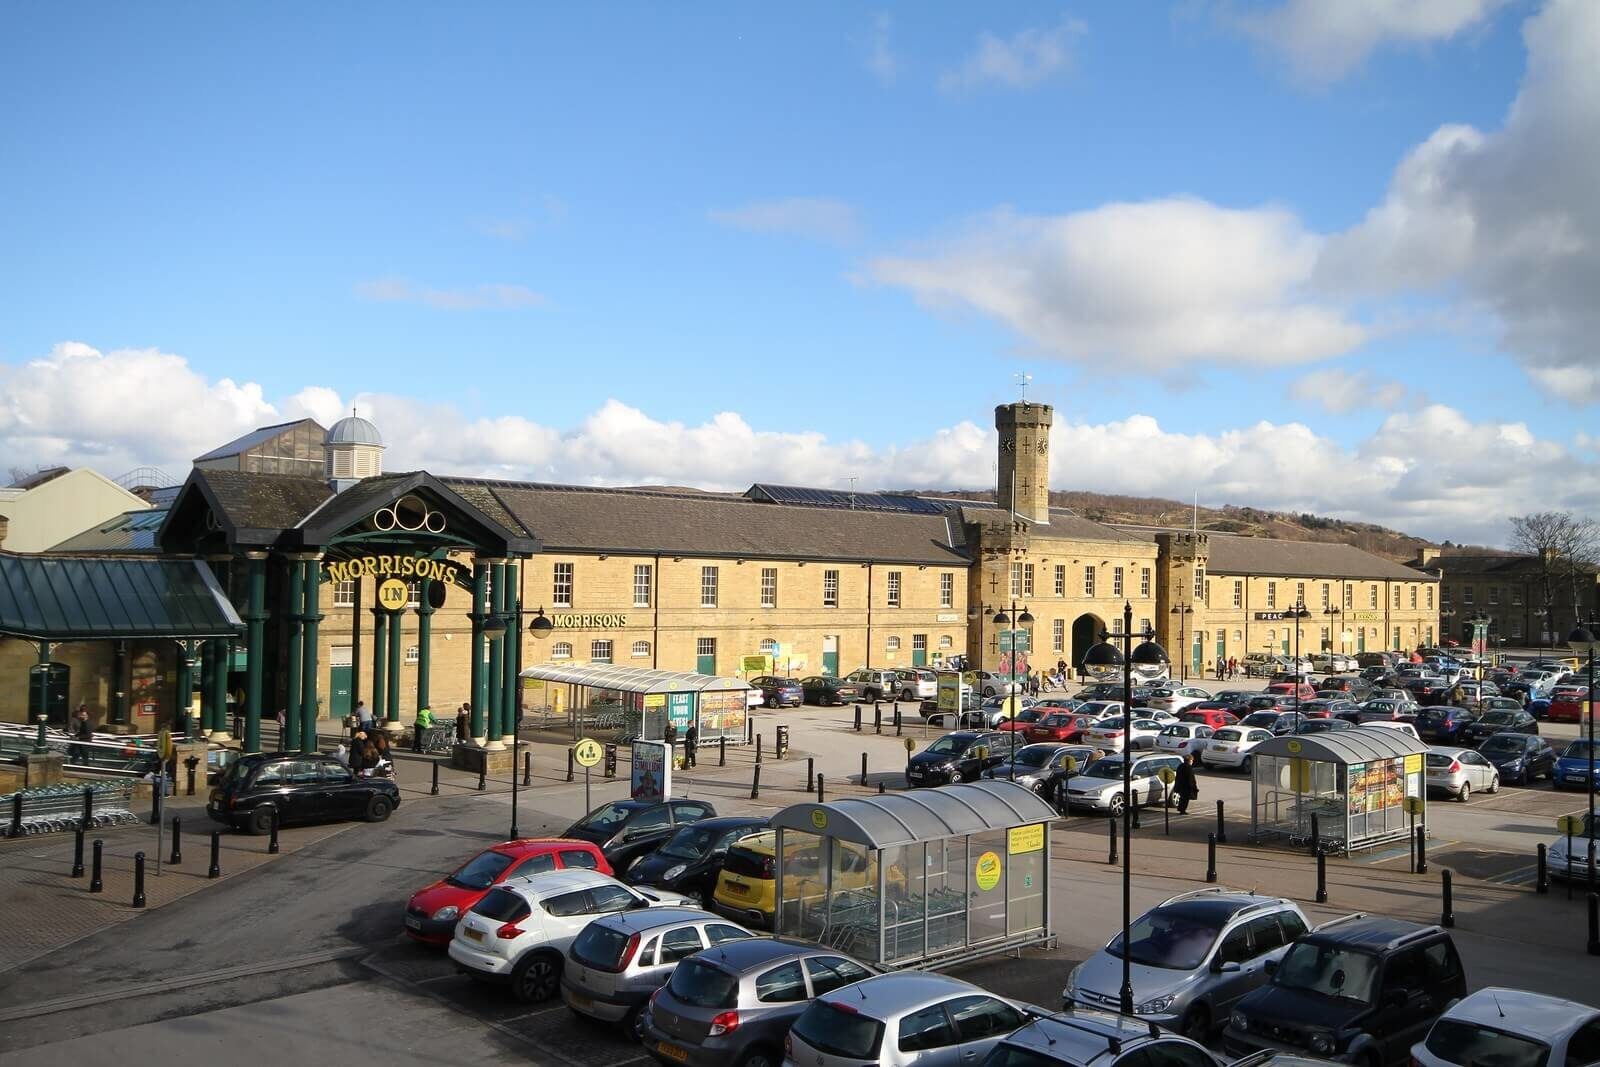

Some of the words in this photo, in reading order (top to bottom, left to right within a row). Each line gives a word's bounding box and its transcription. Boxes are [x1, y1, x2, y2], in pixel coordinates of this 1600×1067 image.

[328, 555, 457, 585] MORRISONS
[383, 588, 403, 601] IN
[553, 614, 626, 627] MORRISONS
